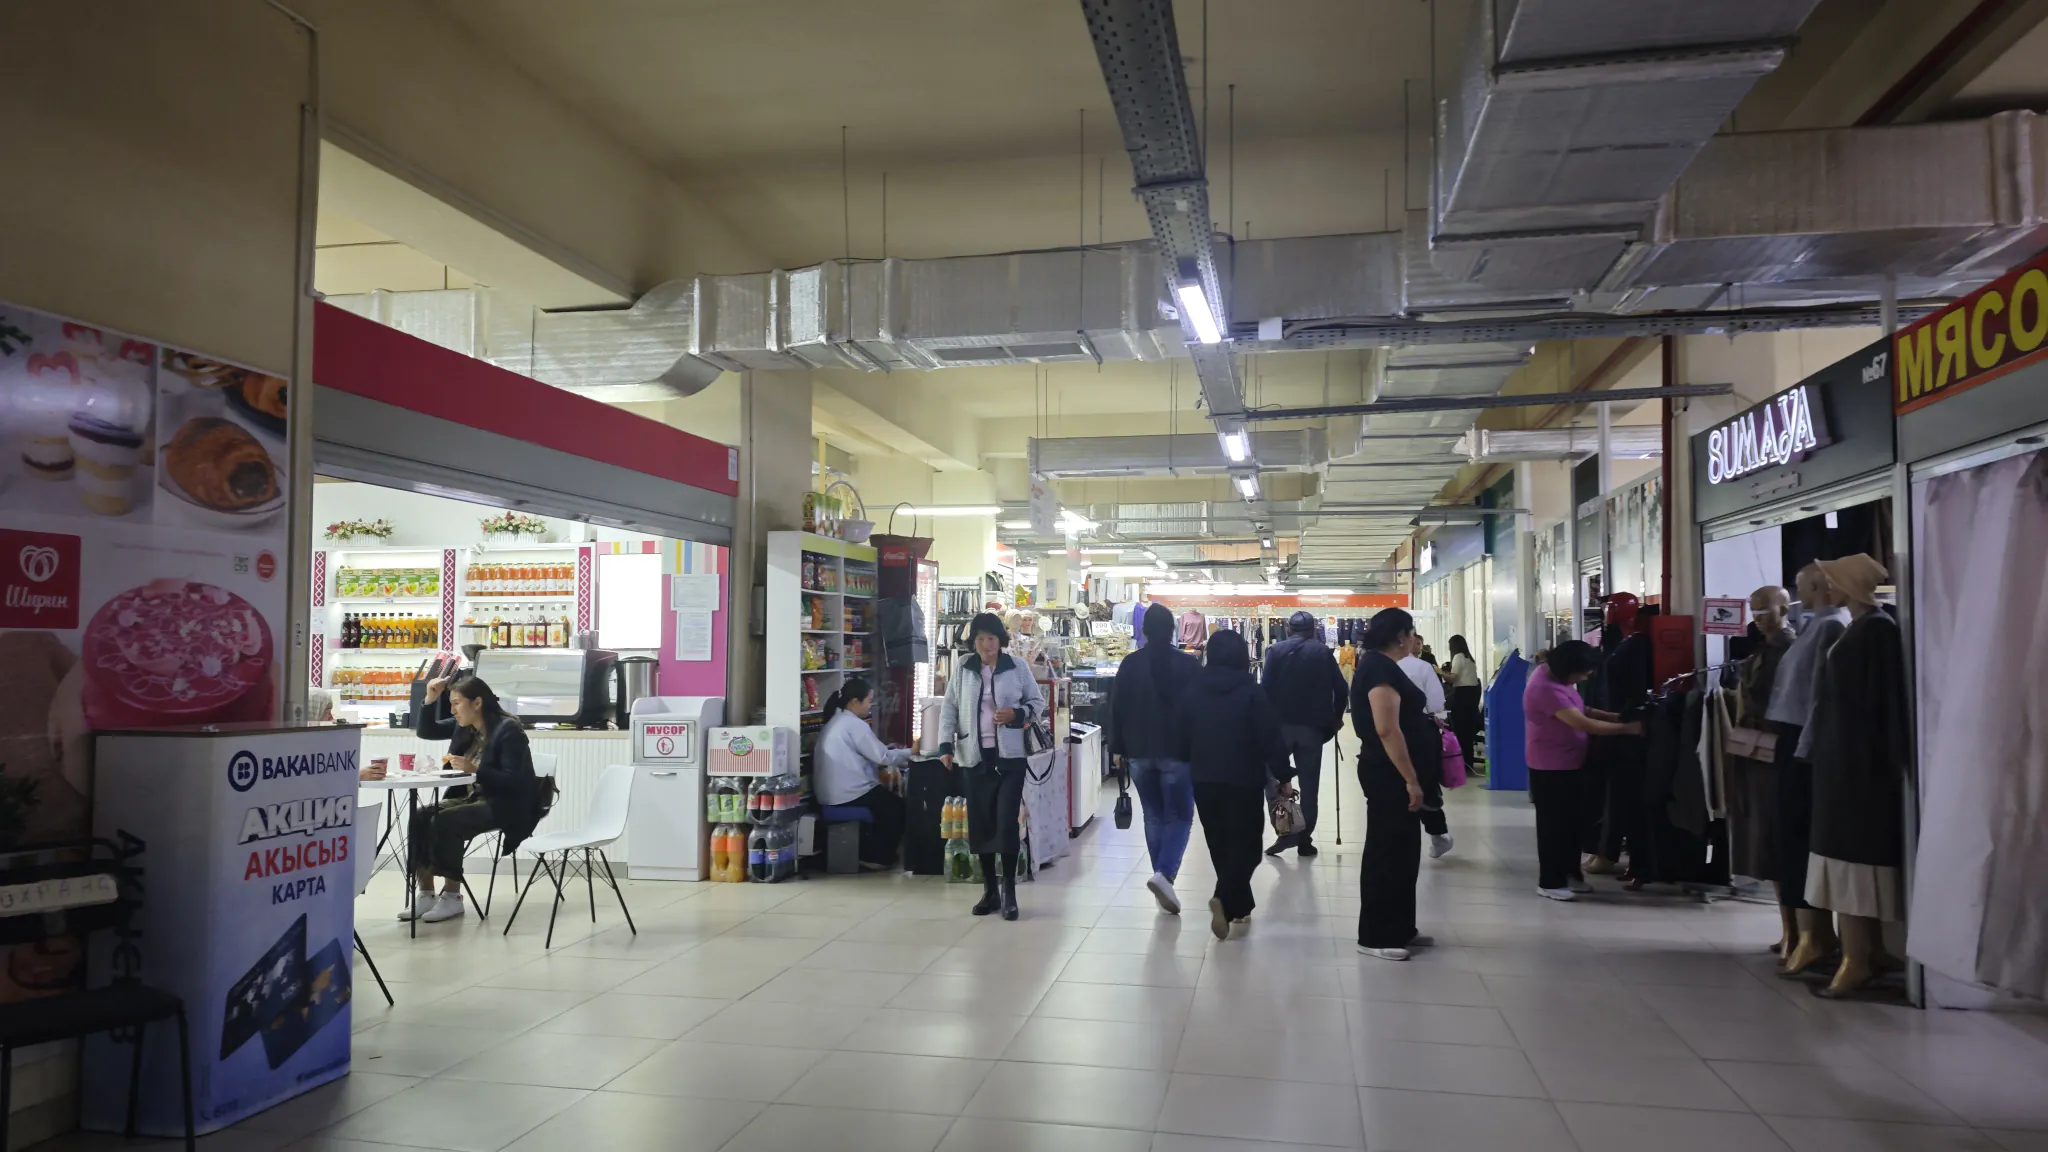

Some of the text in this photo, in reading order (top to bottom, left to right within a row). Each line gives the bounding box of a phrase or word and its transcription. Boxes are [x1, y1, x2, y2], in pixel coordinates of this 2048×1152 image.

[1898, 269, 2048, 403] МЯСО
[1708, 385, 1817, 485] SUMAYA
[5, 584, 68, 615] Ширин
[645, 725, 686, 735] МУСОР
[262, 749, 357, 780] BAKAIBANK
[238, 794, 354, 845] АКЦИЯ
[244, 835, 348, 881] АКЫСЫЗ
[272, 874, 326, 905] КАРТА
